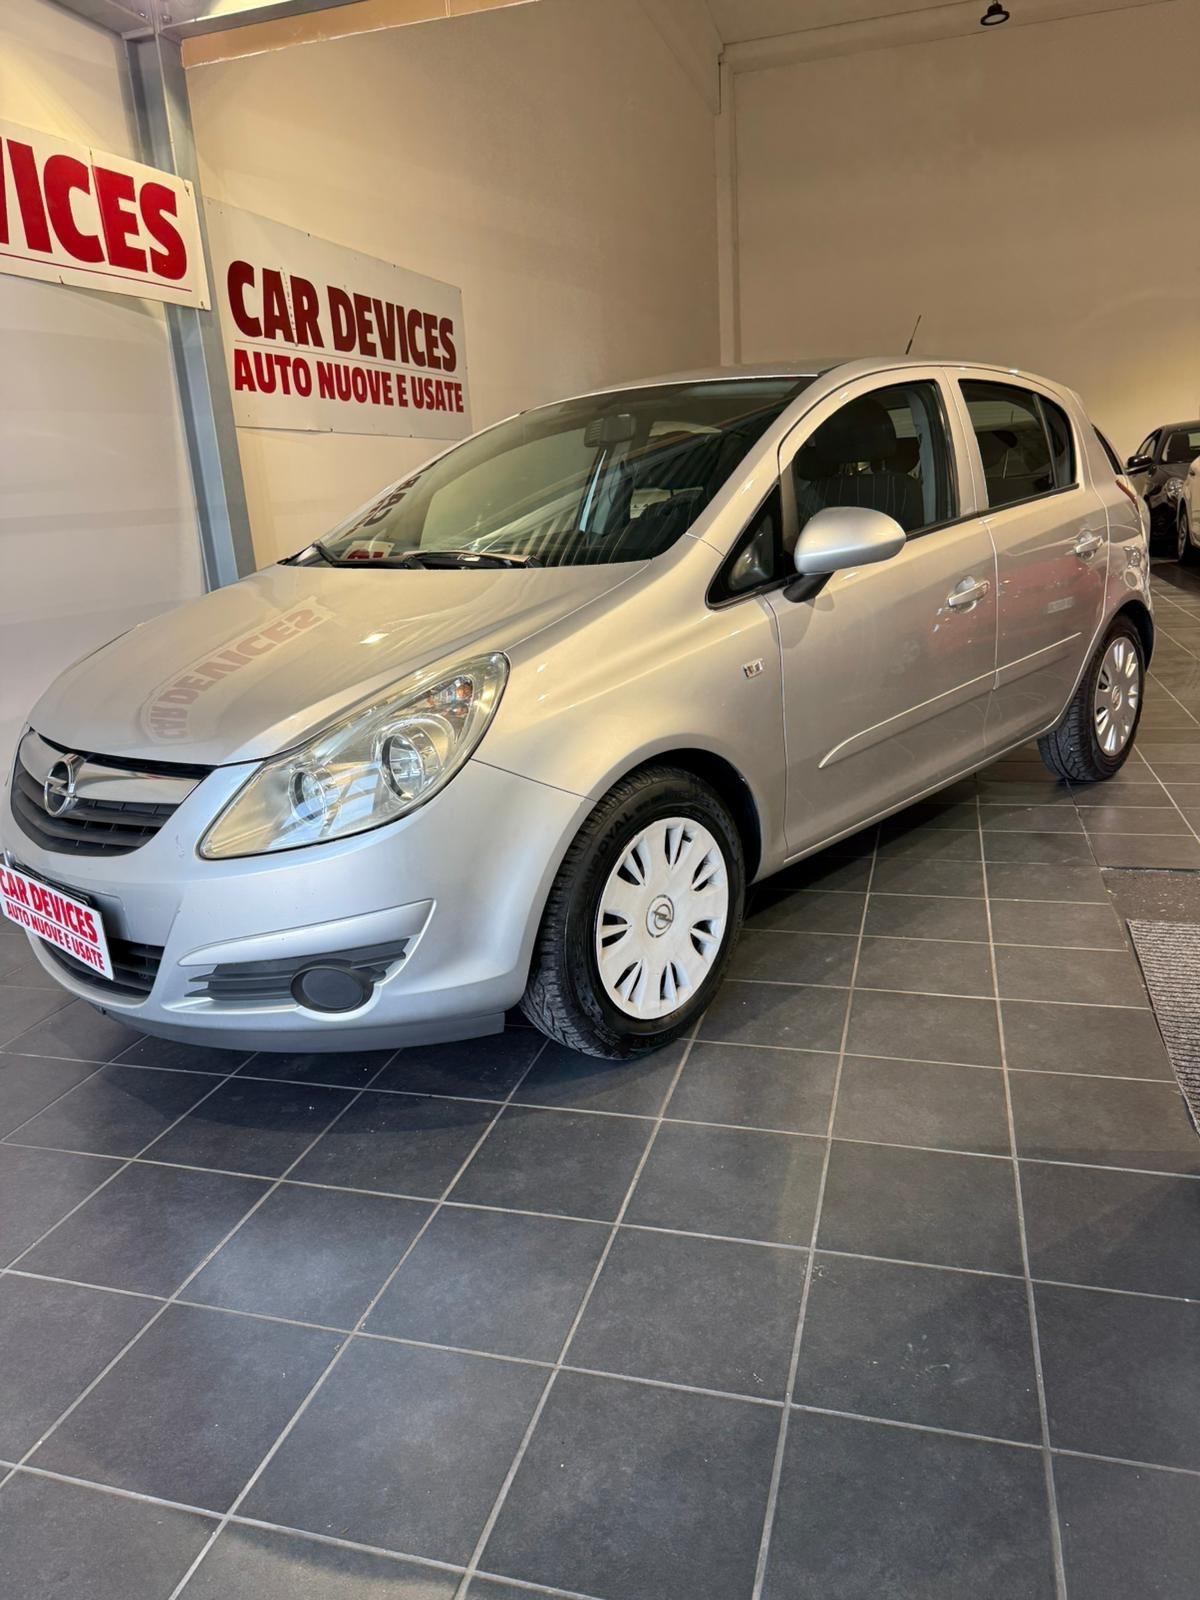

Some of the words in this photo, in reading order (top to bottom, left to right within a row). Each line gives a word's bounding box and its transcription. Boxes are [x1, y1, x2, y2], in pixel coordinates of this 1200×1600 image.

[0, 137, 188, 281] ICES
[226, 260, 324, 348] CAR
[326, 287, 457, 372] DEVICES
[234, 349, 312, 397] AUTO
[317, 361, 394, 406] NUOVE
[396, 374, 408, 408] E
[411, 376, 465, 413] USATE
[0, 868, 30, 906] CAR
[29, 882, 98, 944] DEVICES
[6, 901, 30, 927] AUTO
[30, 914, 64, 946] NUOVE
[65, 933, 71, 950] E
[72, 937, 105, 971] USATE
